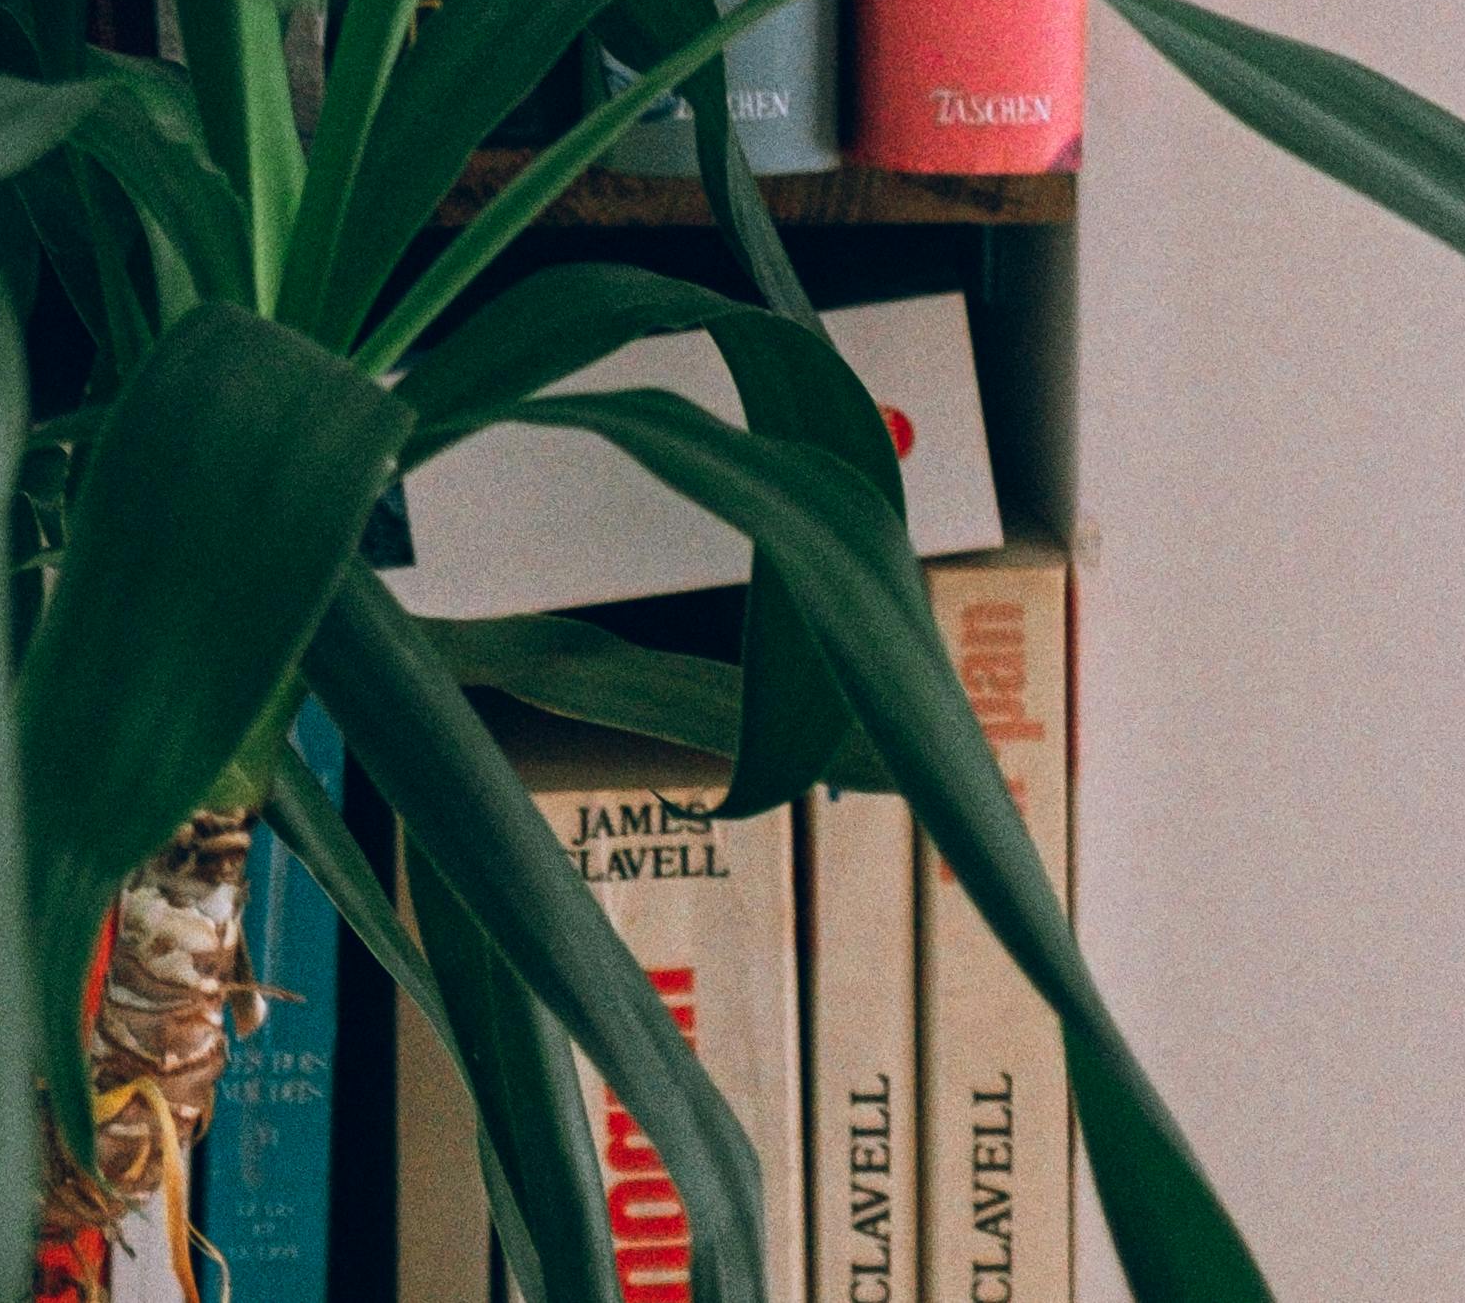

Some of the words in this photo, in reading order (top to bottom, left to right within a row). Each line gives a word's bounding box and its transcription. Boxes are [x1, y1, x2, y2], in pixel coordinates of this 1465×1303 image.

[570, 844, 731, 883] LAVELL
[850, 1071, 892, 1303] CLAVELL
[972, 1070, 1014, 1303] CLAVELL
